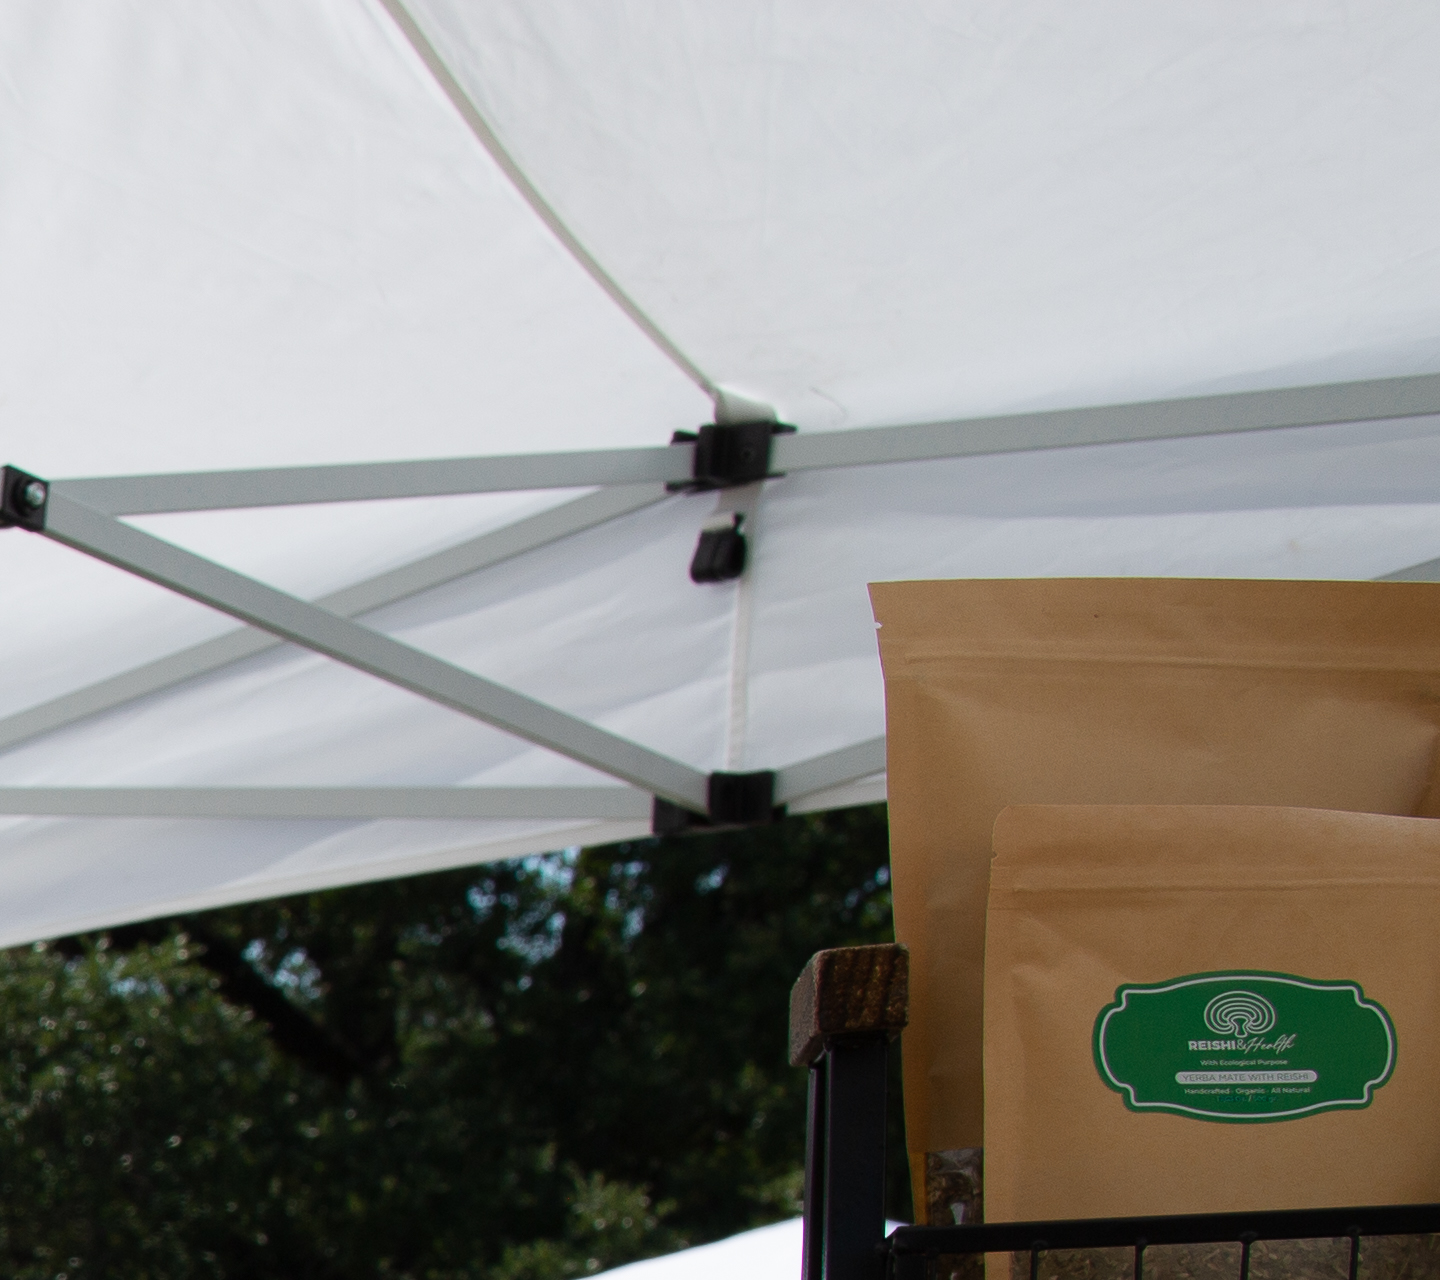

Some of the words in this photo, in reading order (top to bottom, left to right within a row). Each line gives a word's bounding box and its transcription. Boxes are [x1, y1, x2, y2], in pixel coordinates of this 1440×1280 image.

[1220, 1058, 1256, 1067] Ecological
[1258, 1059, 1288, 1067] Purpose
[1183, 1074, 1216, 1083] YERBA
[1220, 1073, 1246, 1082] MATE
[1249, 1073, 1274, 1082] WITH
[1277, 1072, 1309, 1081] REISHI
[1185, 1087, 1230, 1095] Handcrafted
[1236, 1087, 1266, 1096] Organic
[1271, 1086, 1281, 1094] All
[1283, 1086, 1311, 1094] Natural
